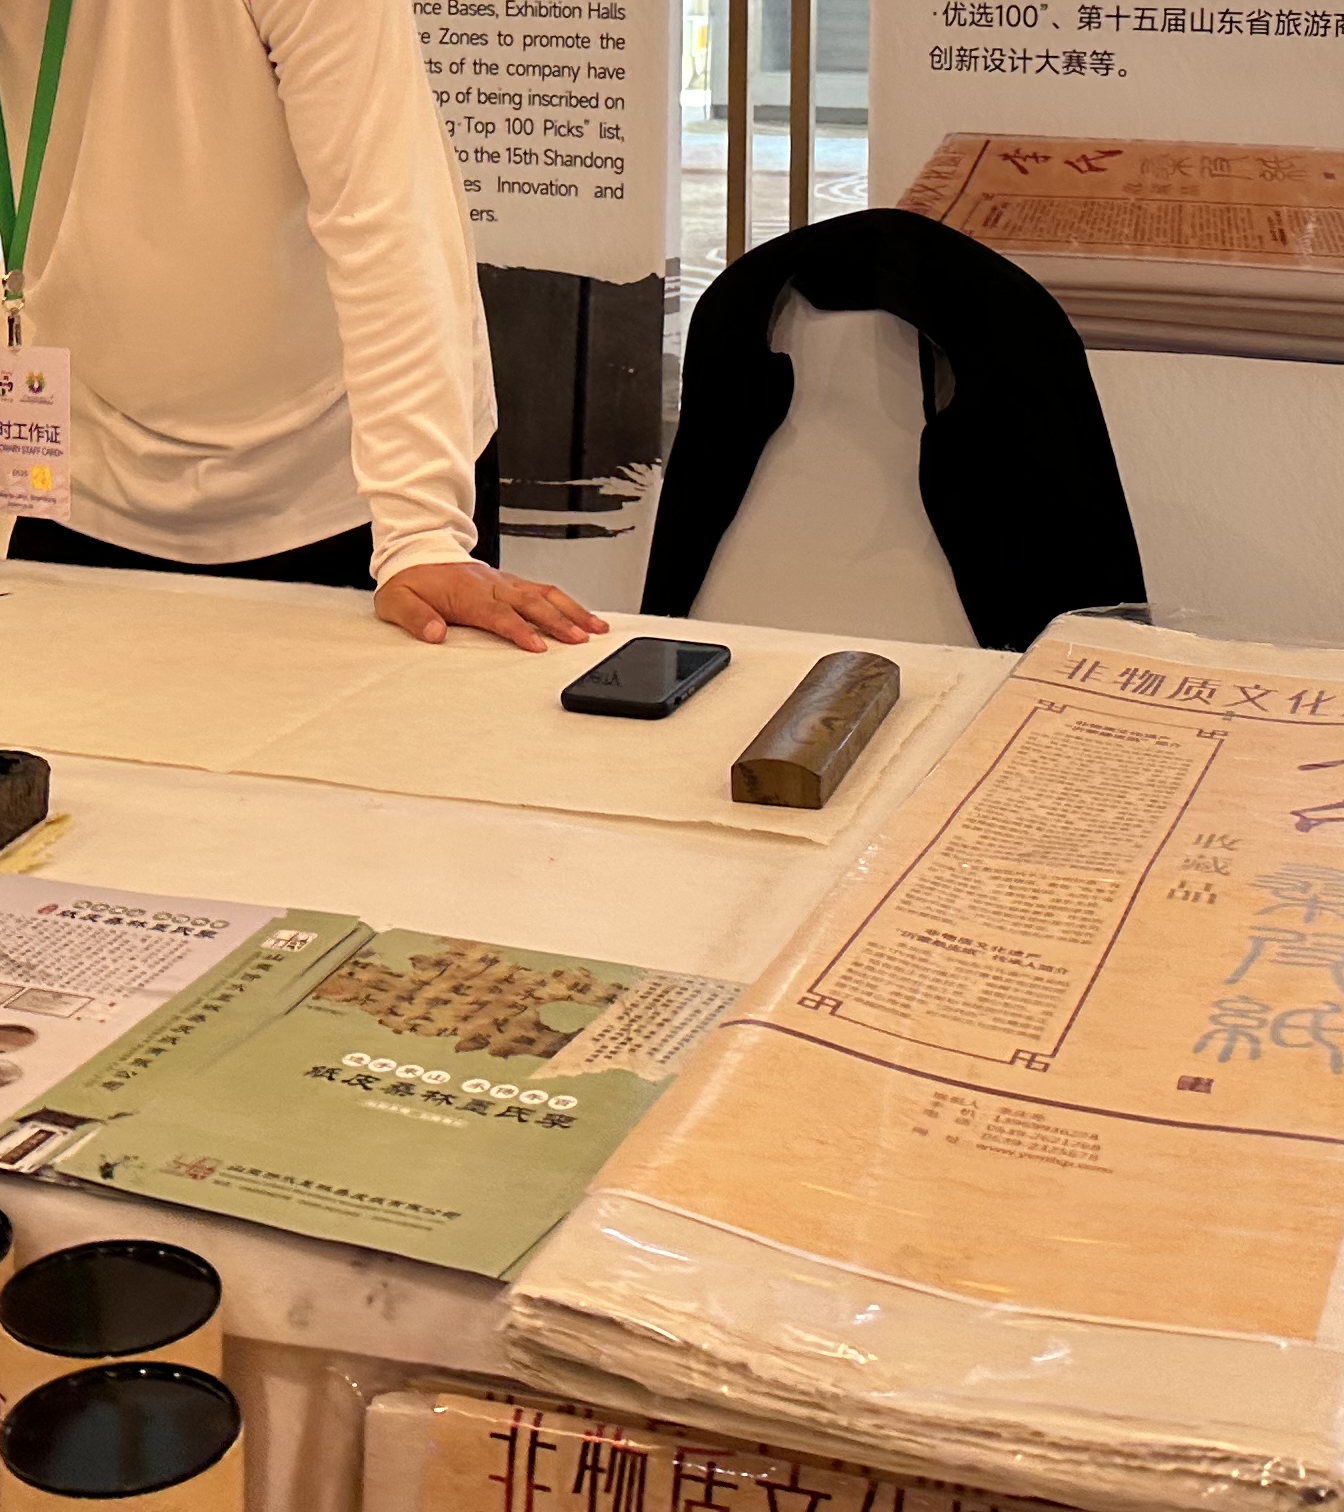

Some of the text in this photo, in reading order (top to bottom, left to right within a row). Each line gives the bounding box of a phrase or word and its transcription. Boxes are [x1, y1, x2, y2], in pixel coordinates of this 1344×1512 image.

[504, 0, 583, 20] Exhibition
[587, 1, 627, 21] Halls
[438, 26, 489, 47] Zones
[496, 29, 515, 48] to
[522, 31, 592, 53] promote
[599, 31, 626, 51] the
[448, 56, 467, 76] of
[471, 57, 500, 76] the
[505, 63, 582, 84] company
[586, 61, 626, 81] have
[928, 44, 1128, 78] 创新设计大赛等。
[454, 85, 473, 105] of
[476, 86, 524, 112] being
[527, 88, 600, 110] inscribed
[603, 96, 625, 111] on
[504, 116, 535, 137] 100
[473, 145, 502, 165] the
[505, 146, 540, 166] 15th
[542, 147, 625, 176] Shandong
[496, 175, 579, 198] Innovation
[593, 182, 625, 201] and
[1166, 833, 1243, 907] 收藏品
